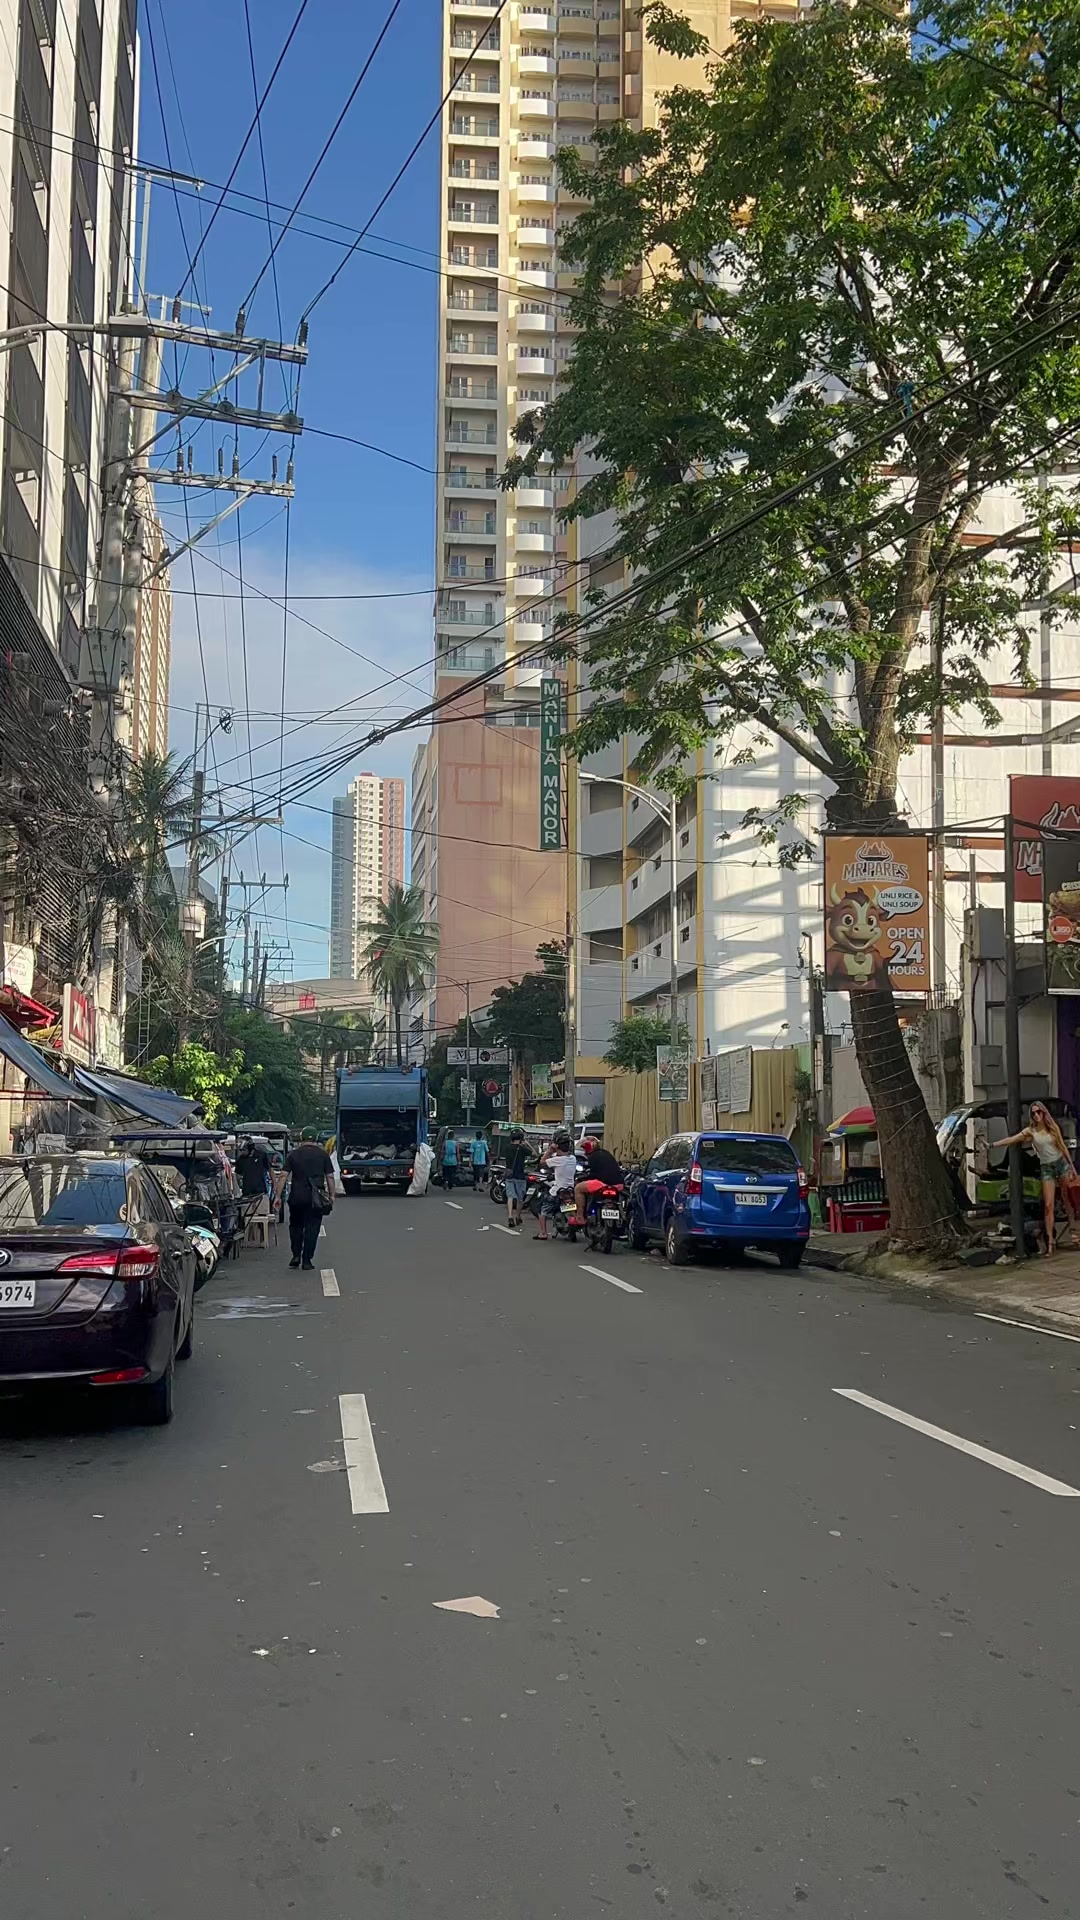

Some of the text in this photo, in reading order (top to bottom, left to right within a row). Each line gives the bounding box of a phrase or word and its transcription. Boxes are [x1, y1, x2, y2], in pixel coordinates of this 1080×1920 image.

[543, 682, 559, 844] MANILA MANOR
[880, 892, 896, 900] UNLI
[897, 892, 913, 900] RICE
[887, 927, 925, 940] OPEN
[889, 940, 925, 965] 24
[887, 965, 926, 976] HOURS
